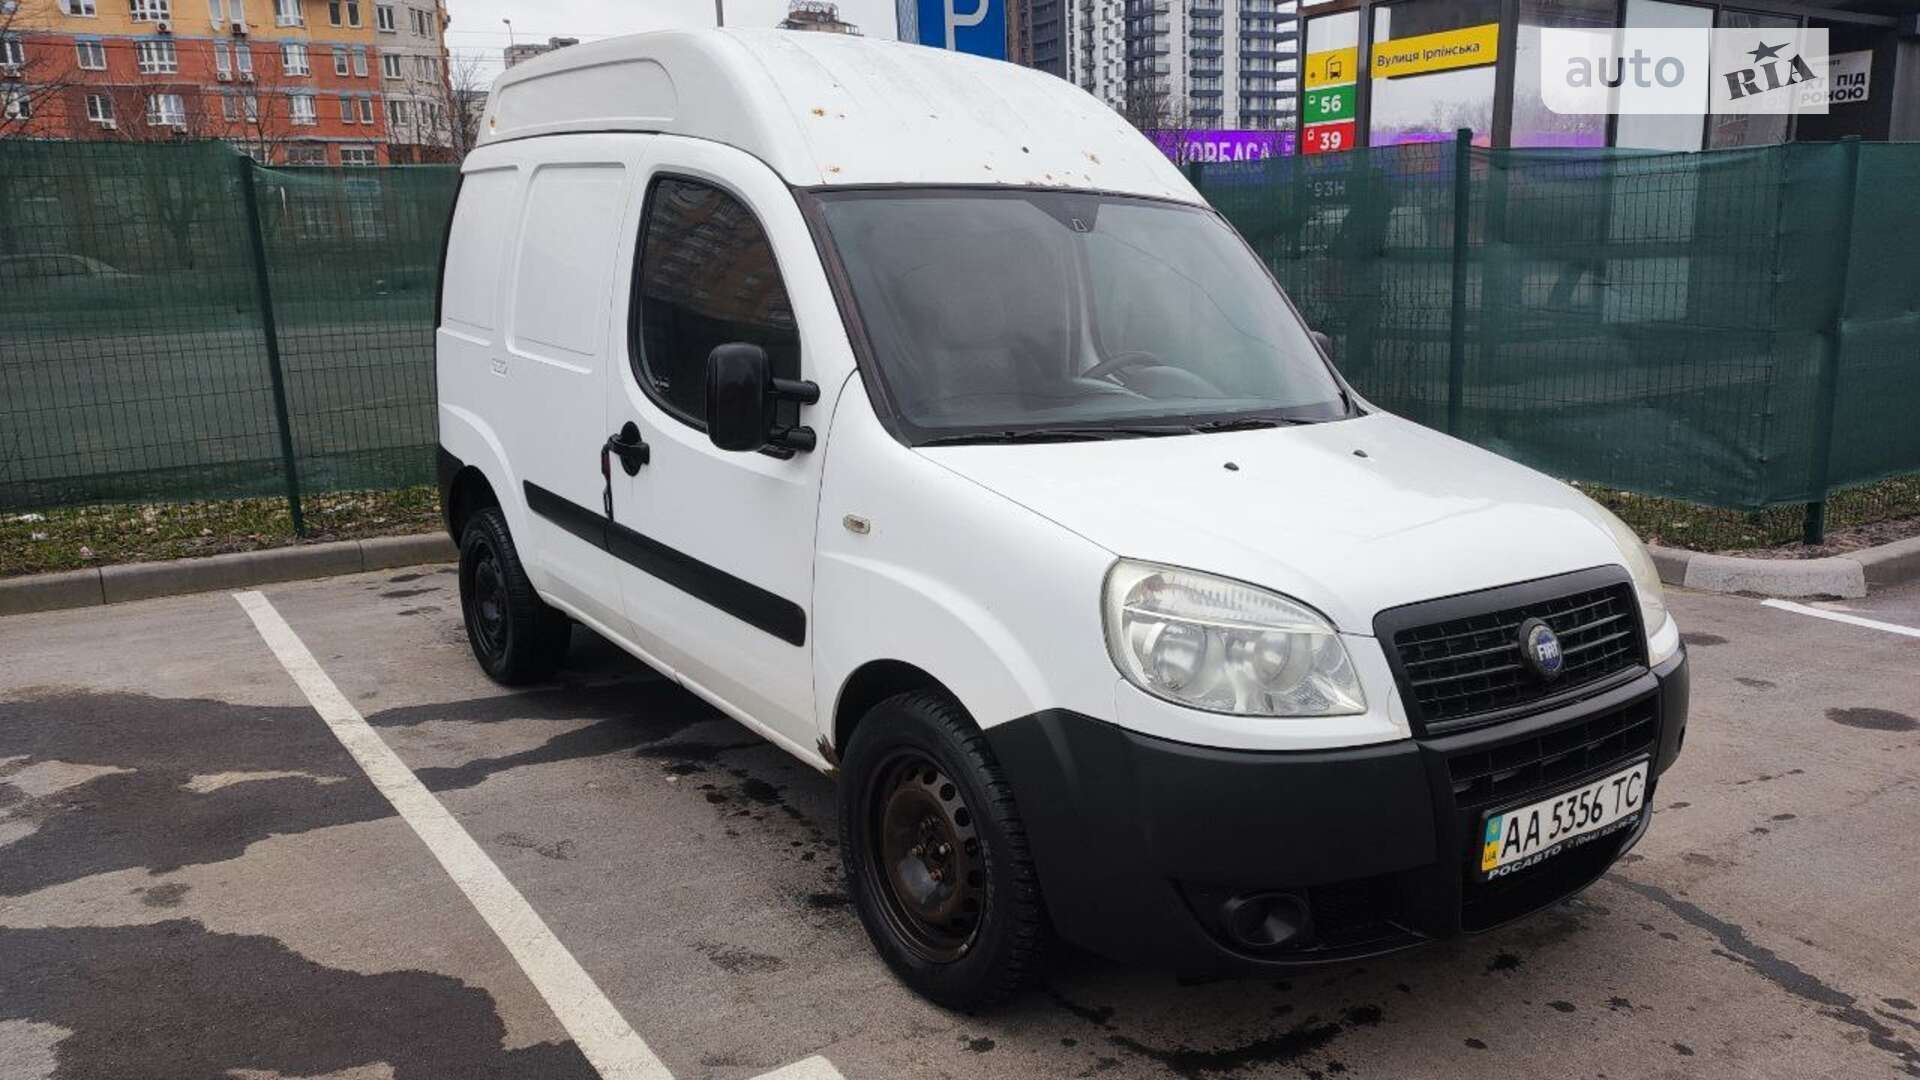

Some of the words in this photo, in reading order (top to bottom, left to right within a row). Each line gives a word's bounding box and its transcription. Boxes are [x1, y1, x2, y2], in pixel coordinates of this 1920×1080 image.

[943, 0, 990, 51] P
[1377, 51, 1420, 68] Вулиця
[1423, 42, 1481, 62] Ірпінська
[1837, 71, 1866, 87] ПІД
[1320, 94, 1342, 113] 56
[1319, 131, 1342, 150] 39
[1501, 810, 1540, 858] AA
[1549, 784, 1605, 840] 5356
[1612, 771, 1641, 815] TC
[1487, 845, 1562, 881] РОСАВТО
